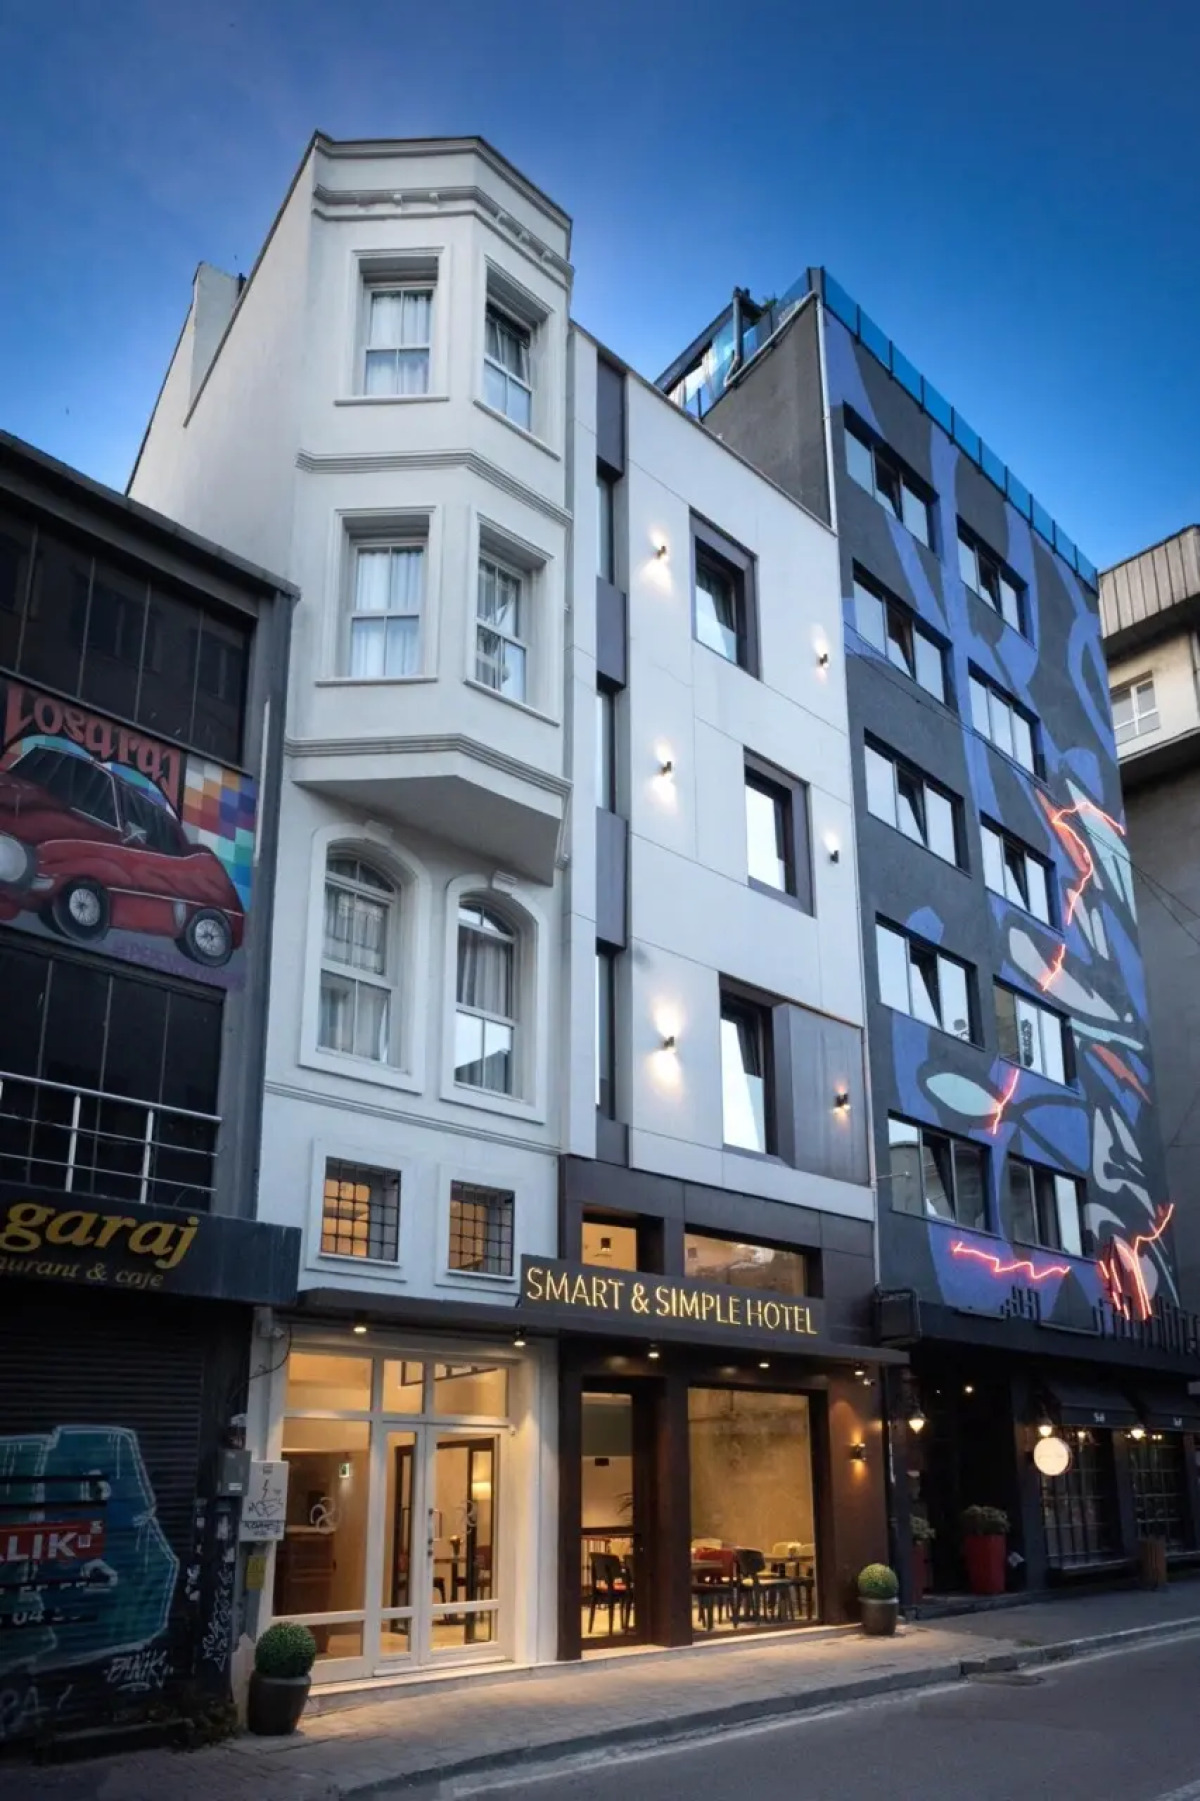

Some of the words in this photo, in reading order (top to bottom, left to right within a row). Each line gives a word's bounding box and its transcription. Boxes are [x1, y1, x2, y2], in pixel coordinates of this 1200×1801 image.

[0, 1202, 201, 1270] garaj
[86, 1262, 108, 1281] &
[526, 1266, 625, 1310] SMART
[631, 1282, 650, 1315] &
[655, 1284, 742, 1326] SIMPLE
[746, 1298, 819, 1335] HOTEL
[0, 1531, 78, 1562] LIK
